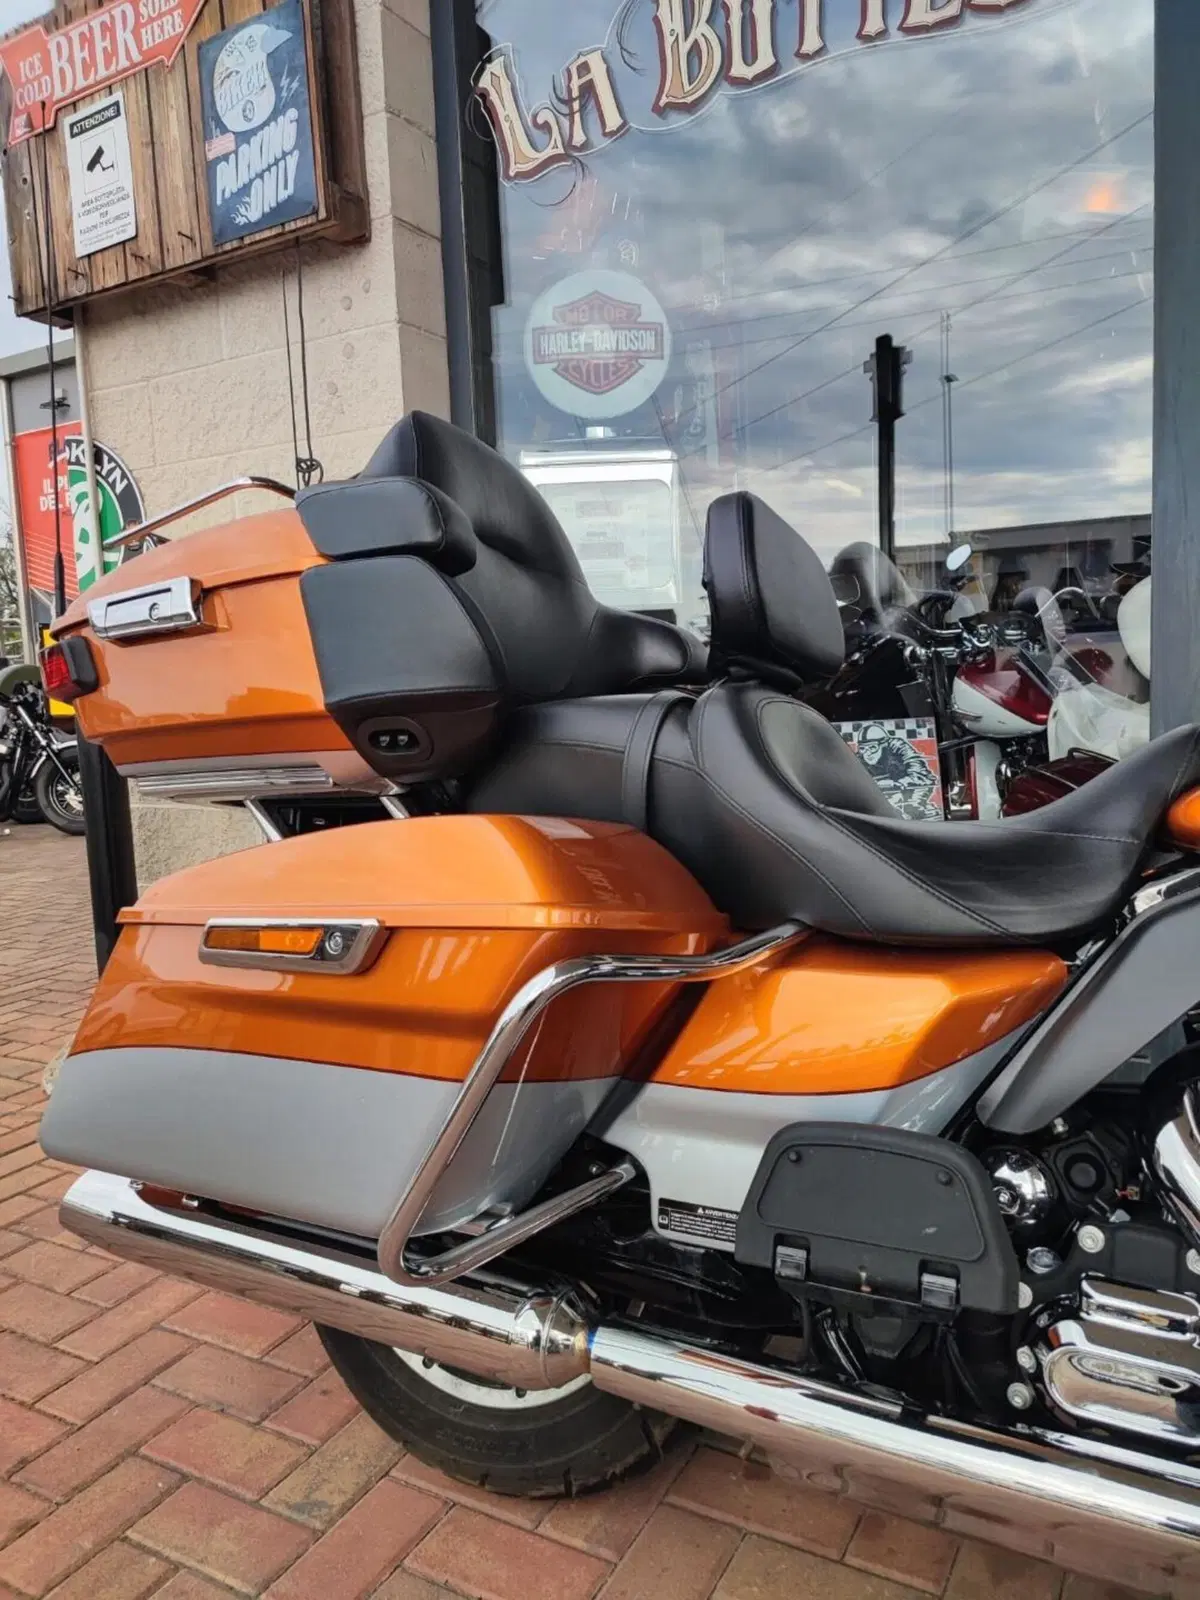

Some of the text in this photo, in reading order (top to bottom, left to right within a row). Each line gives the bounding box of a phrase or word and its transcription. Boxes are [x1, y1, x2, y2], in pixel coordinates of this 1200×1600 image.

[140, 0, 178, 23] SOL
[141, 9, 183, 50] HERE
[19, 53, 43, 82] ICE
[49, 2, 142, 101] BEER
[16, 75, 50, 110] COLD
[72, 106, 117, 136] ATTENZIONE!
[475, 49, 630, 178] LA
[217, 111, 298, 206] PARKING
[249, 149, 299, 223] ONLY
[540, 329, 656, 356] HARLEY-DAVIDSON
[568, 358, 630, 386] CYCLES
